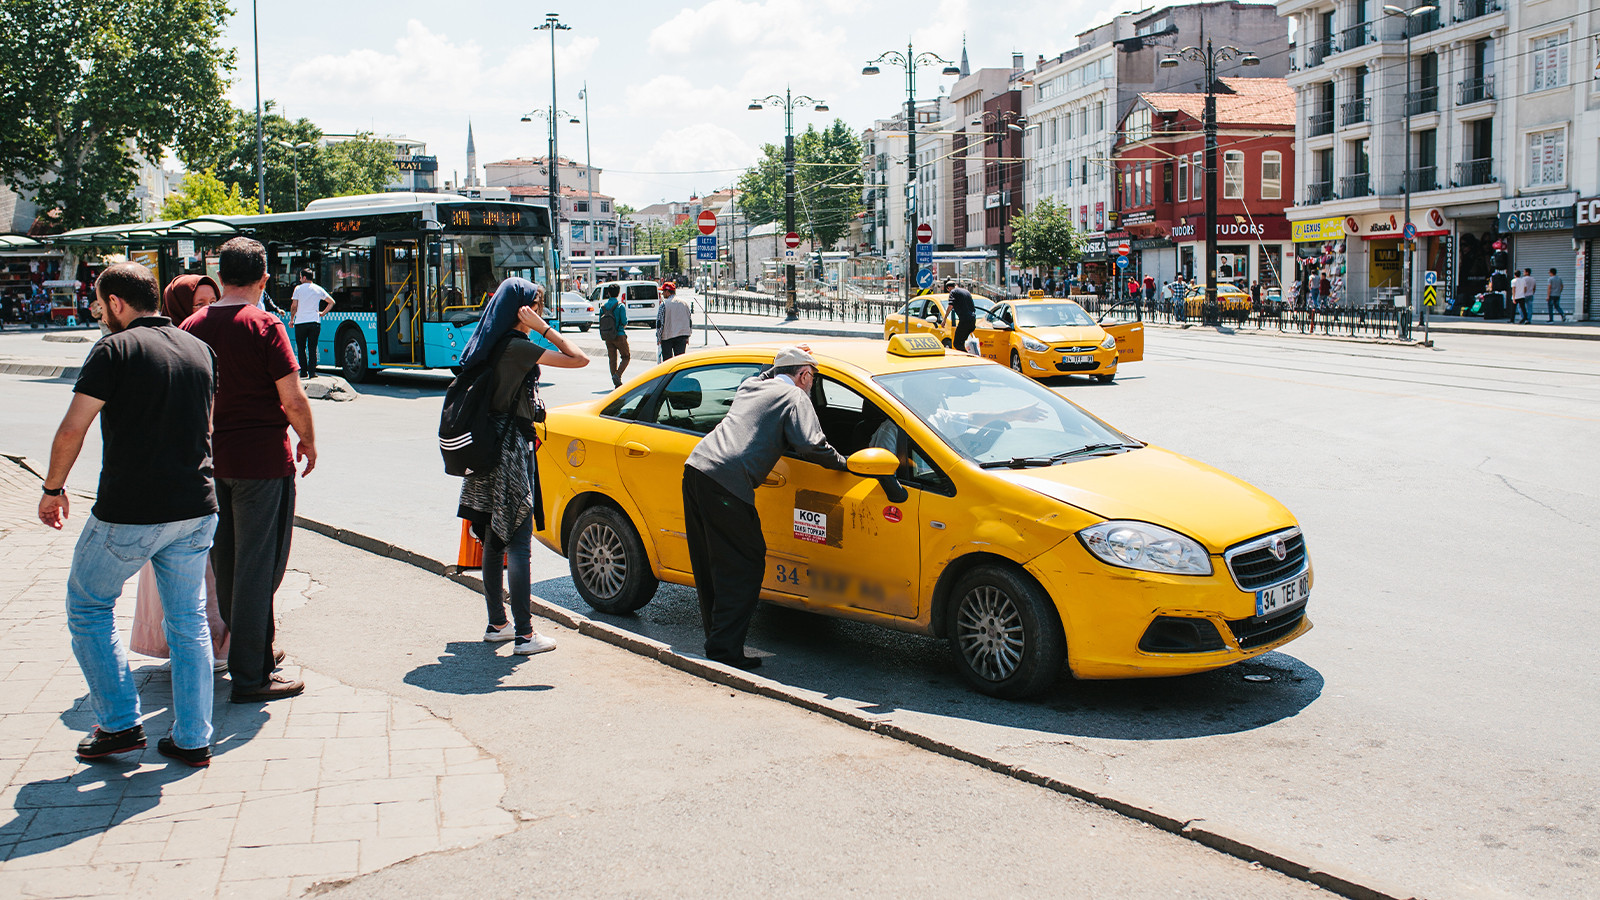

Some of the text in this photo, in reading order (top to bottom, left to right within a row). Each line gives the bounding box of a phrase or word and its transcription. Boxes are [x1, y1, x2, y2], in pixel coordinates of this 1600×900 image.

[1172, 224, 1194, 236] TUDORS
[1216, 223, 1264, 235] TUDORS
[1303, 223, 1321, 233] LEXUS
[1519, 220, 1564, 230] KUYUMCUSU
[799, 511, 820, 525] KOÇ
[776, 564, 800, 585] 34
[1263, 590, 1276, 610] 34
[1281, 582, 1296, 604] TEF
